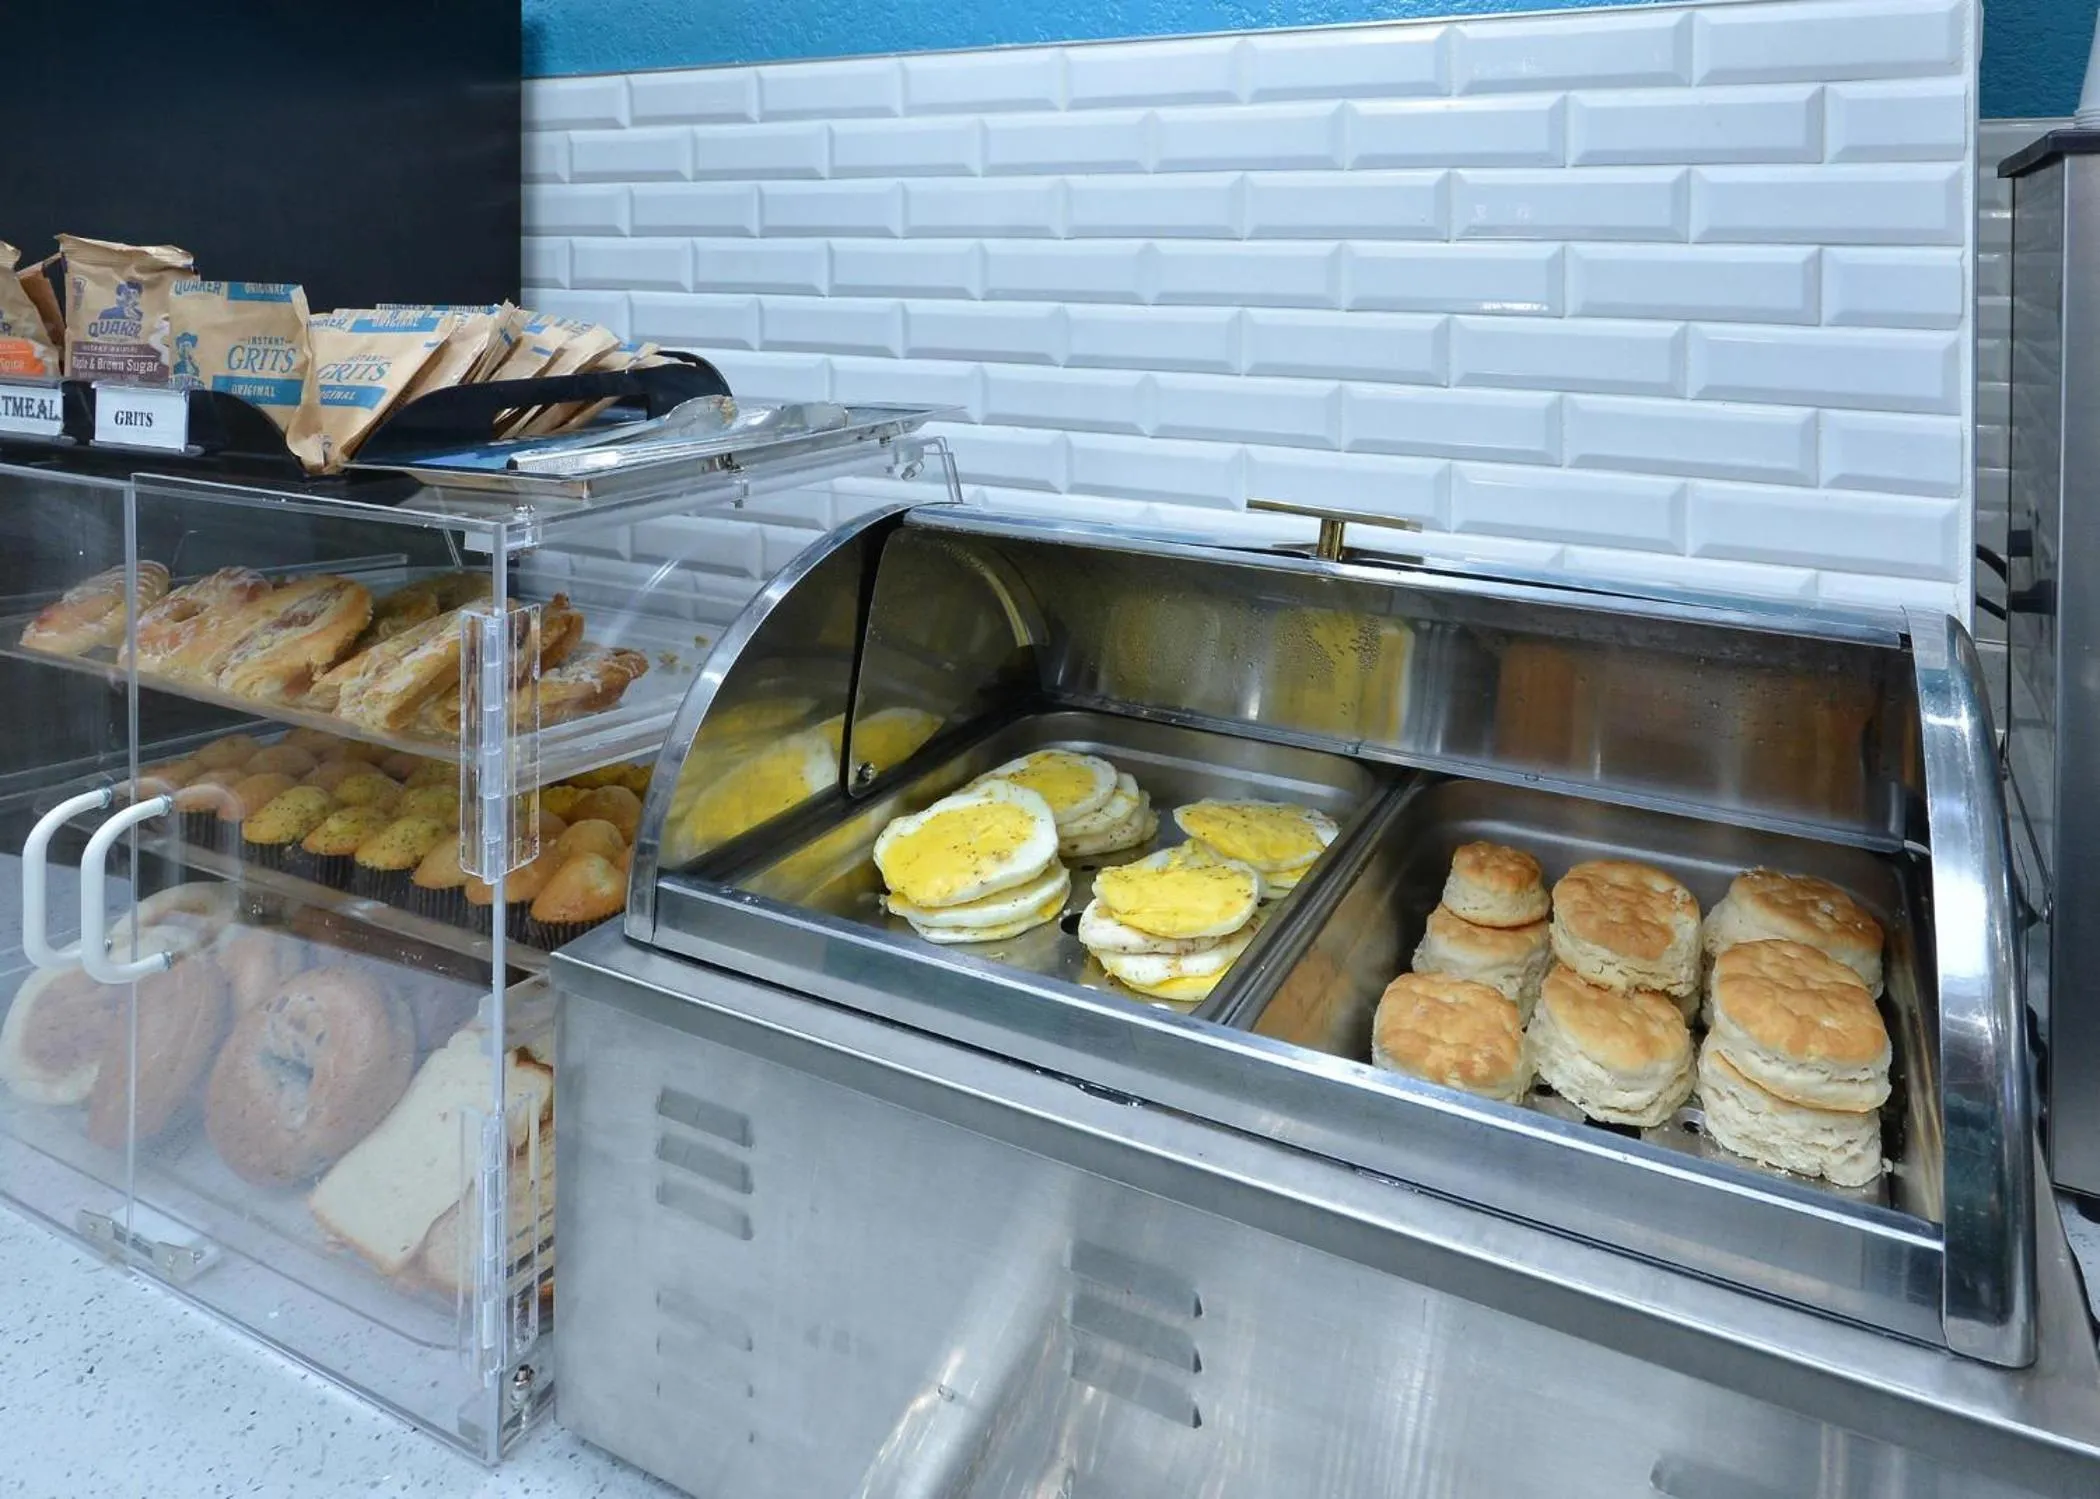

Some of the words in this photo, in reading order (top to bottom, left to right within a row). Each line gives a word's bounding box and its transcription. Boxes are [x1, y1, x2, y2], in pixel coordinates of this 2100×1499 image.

[174, 280, 222, 295] QUAKER
[89, 321, 143, 340] QUAKER
[248, 335, 284, 346] INSTANT
[97, 358, 124, 371] Brown
[126, 358, 158, 375] Sugar
[227, 345, 297, 373] GRITS
[317, 361, 392, 383] GRITS
[231, 383, 275, 397] ORIGINAL
[0, 395, 61, 422] TMEAL
[113, 409, 153, 428] GRITS
